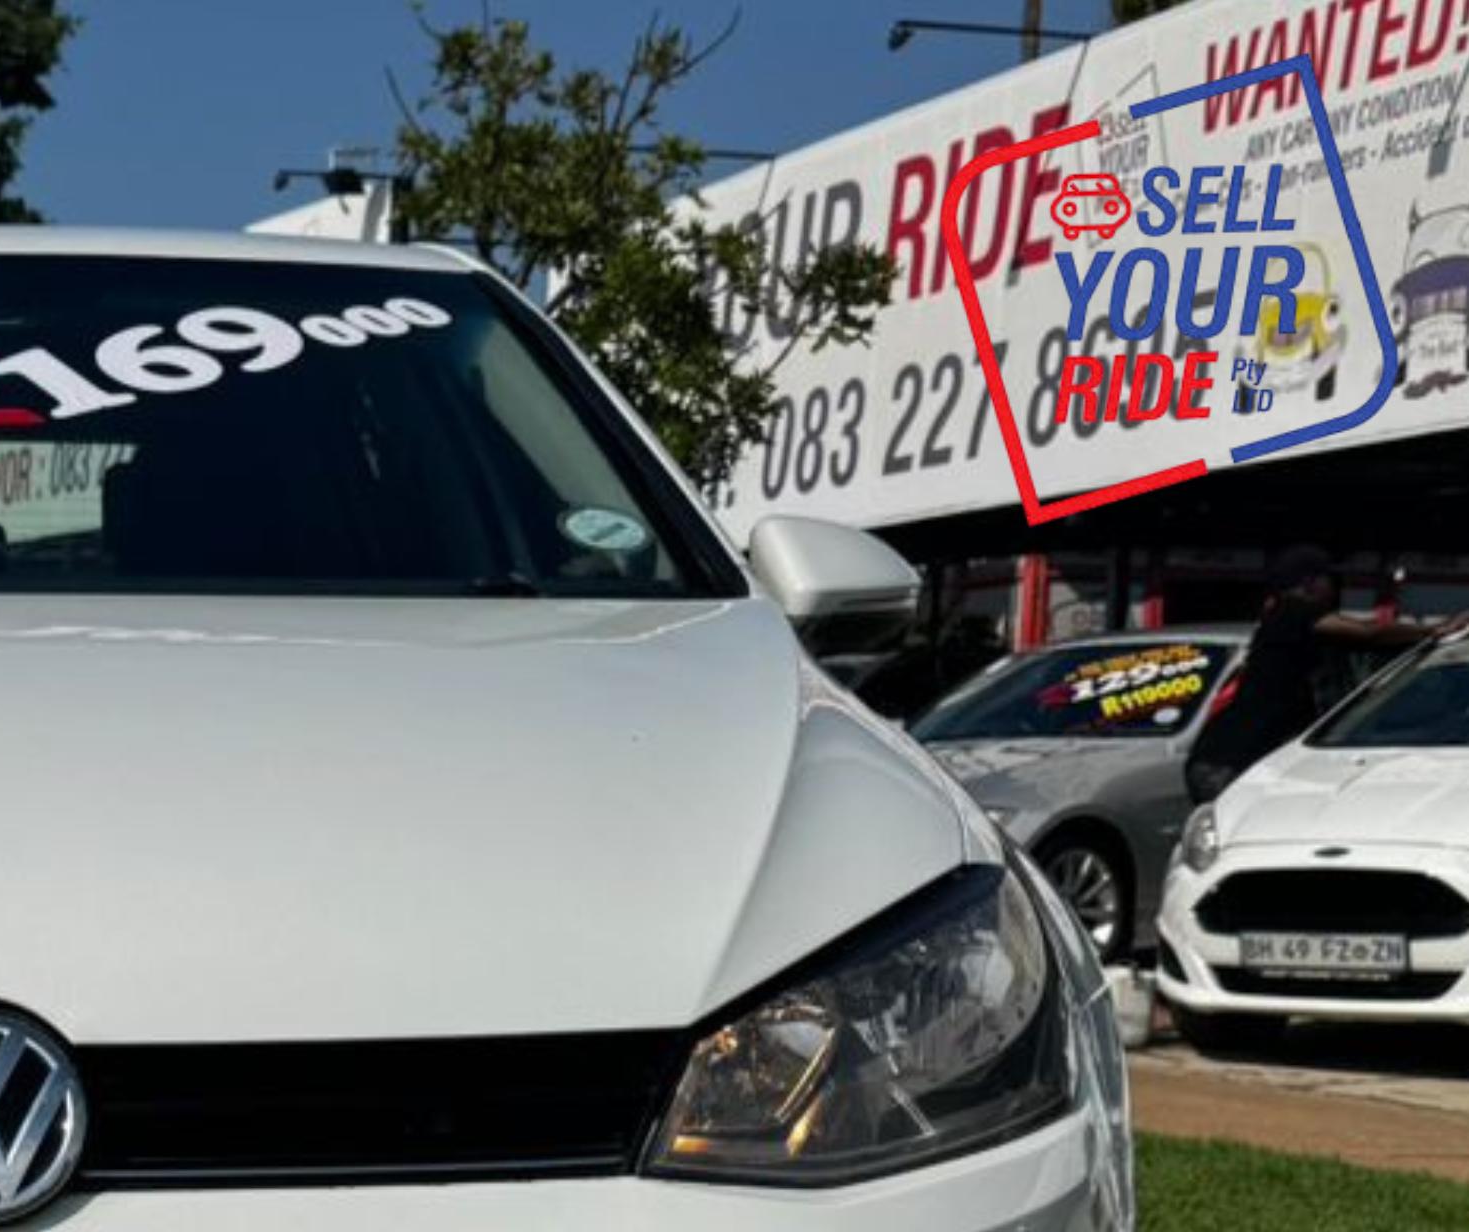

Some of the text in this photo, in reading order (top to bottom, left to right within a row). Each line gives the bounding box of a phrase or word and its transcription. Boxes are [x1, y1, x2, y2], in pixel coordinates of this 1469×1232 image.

[889, 101, 1073, 300] RIDE
[761, 377, 867, 500] 083
[882, 340, 1009, 477] 227
